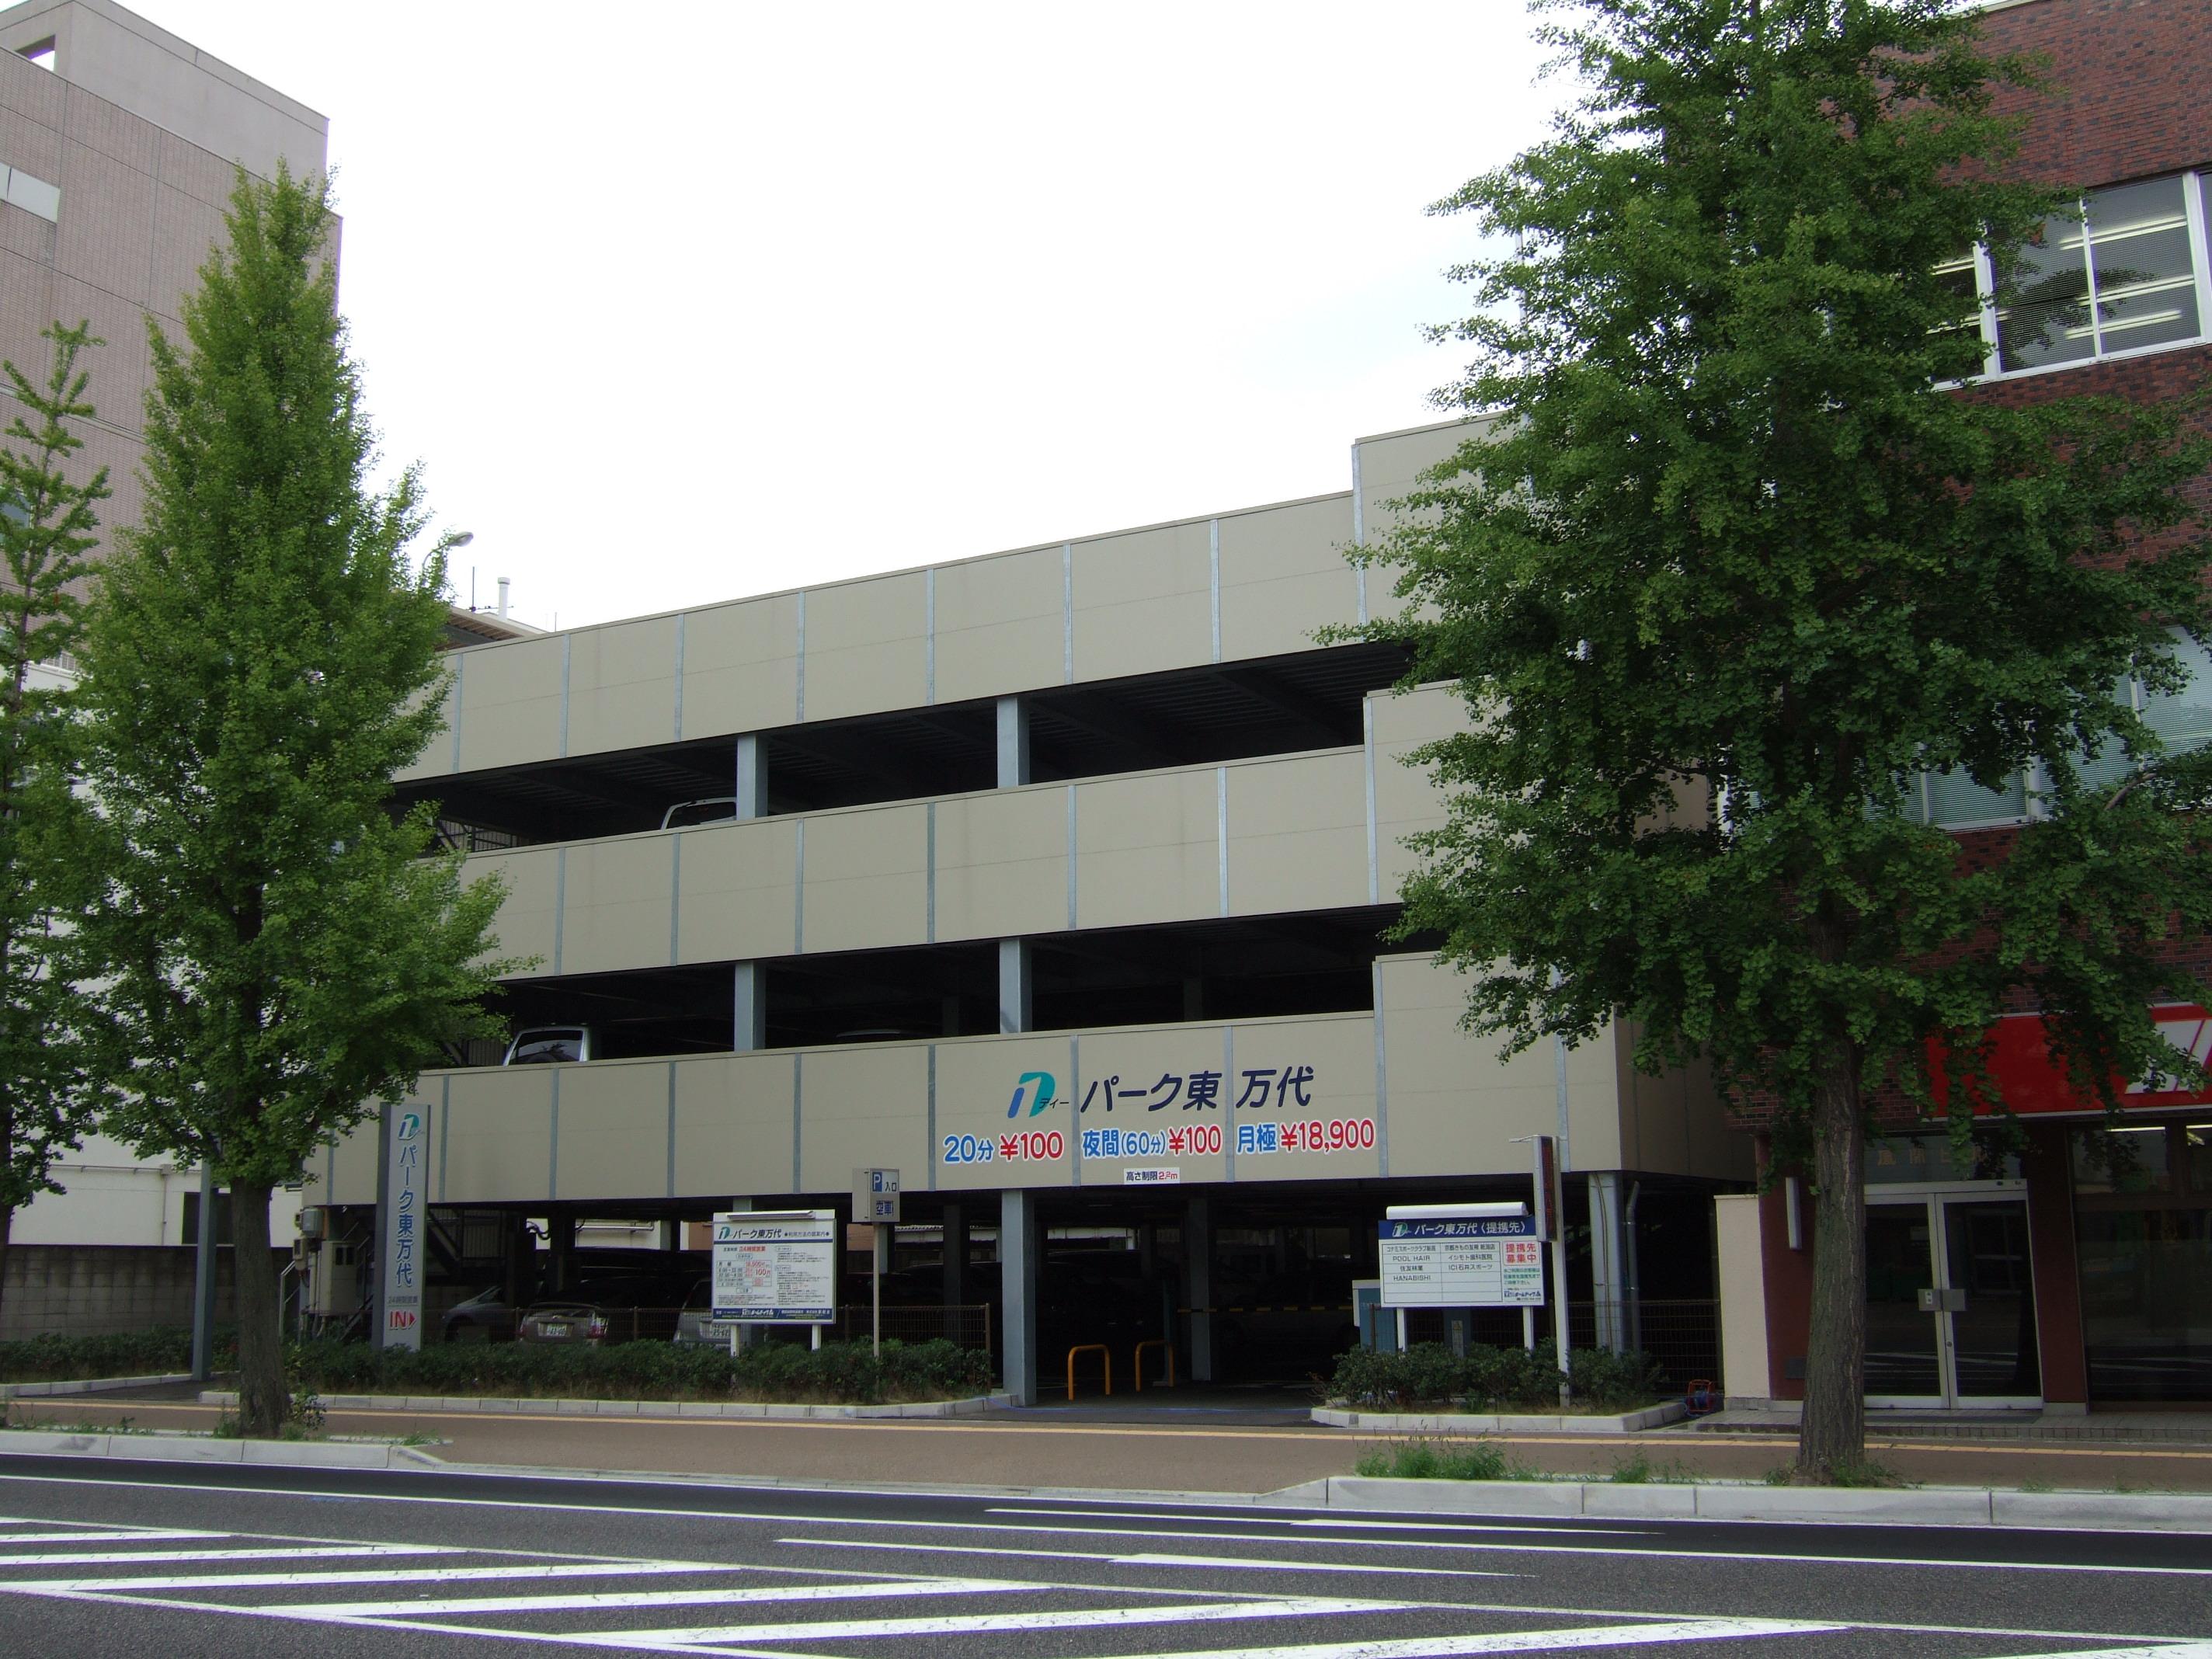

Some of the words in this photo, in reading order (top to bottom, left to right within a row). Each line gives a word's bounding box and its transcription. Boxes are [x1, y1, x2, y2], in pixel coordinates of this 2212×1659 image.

[1080, 1065, 1314, 1113] パーク東万代
[944, 1135, 994, 1163] 20分
[999, 1130, 1064, 1161] ¥100
[1168, 1125, 1222, 1155] ¥100
[1236, 1124, 1277, 1154] 月極
[1280, 1118, 1375, 1153] ¥18,900
[873, 1174, 882, 1191] P
[885, 1181, 897, 1192] 入口
[395, 1144, 419, 1288] パーク東万代
[732, 1228, 782, 1240] パーク東万代
[1506, 1243, 1536, 1253] 提携先
[389, 1310, 408, 1329] IN
